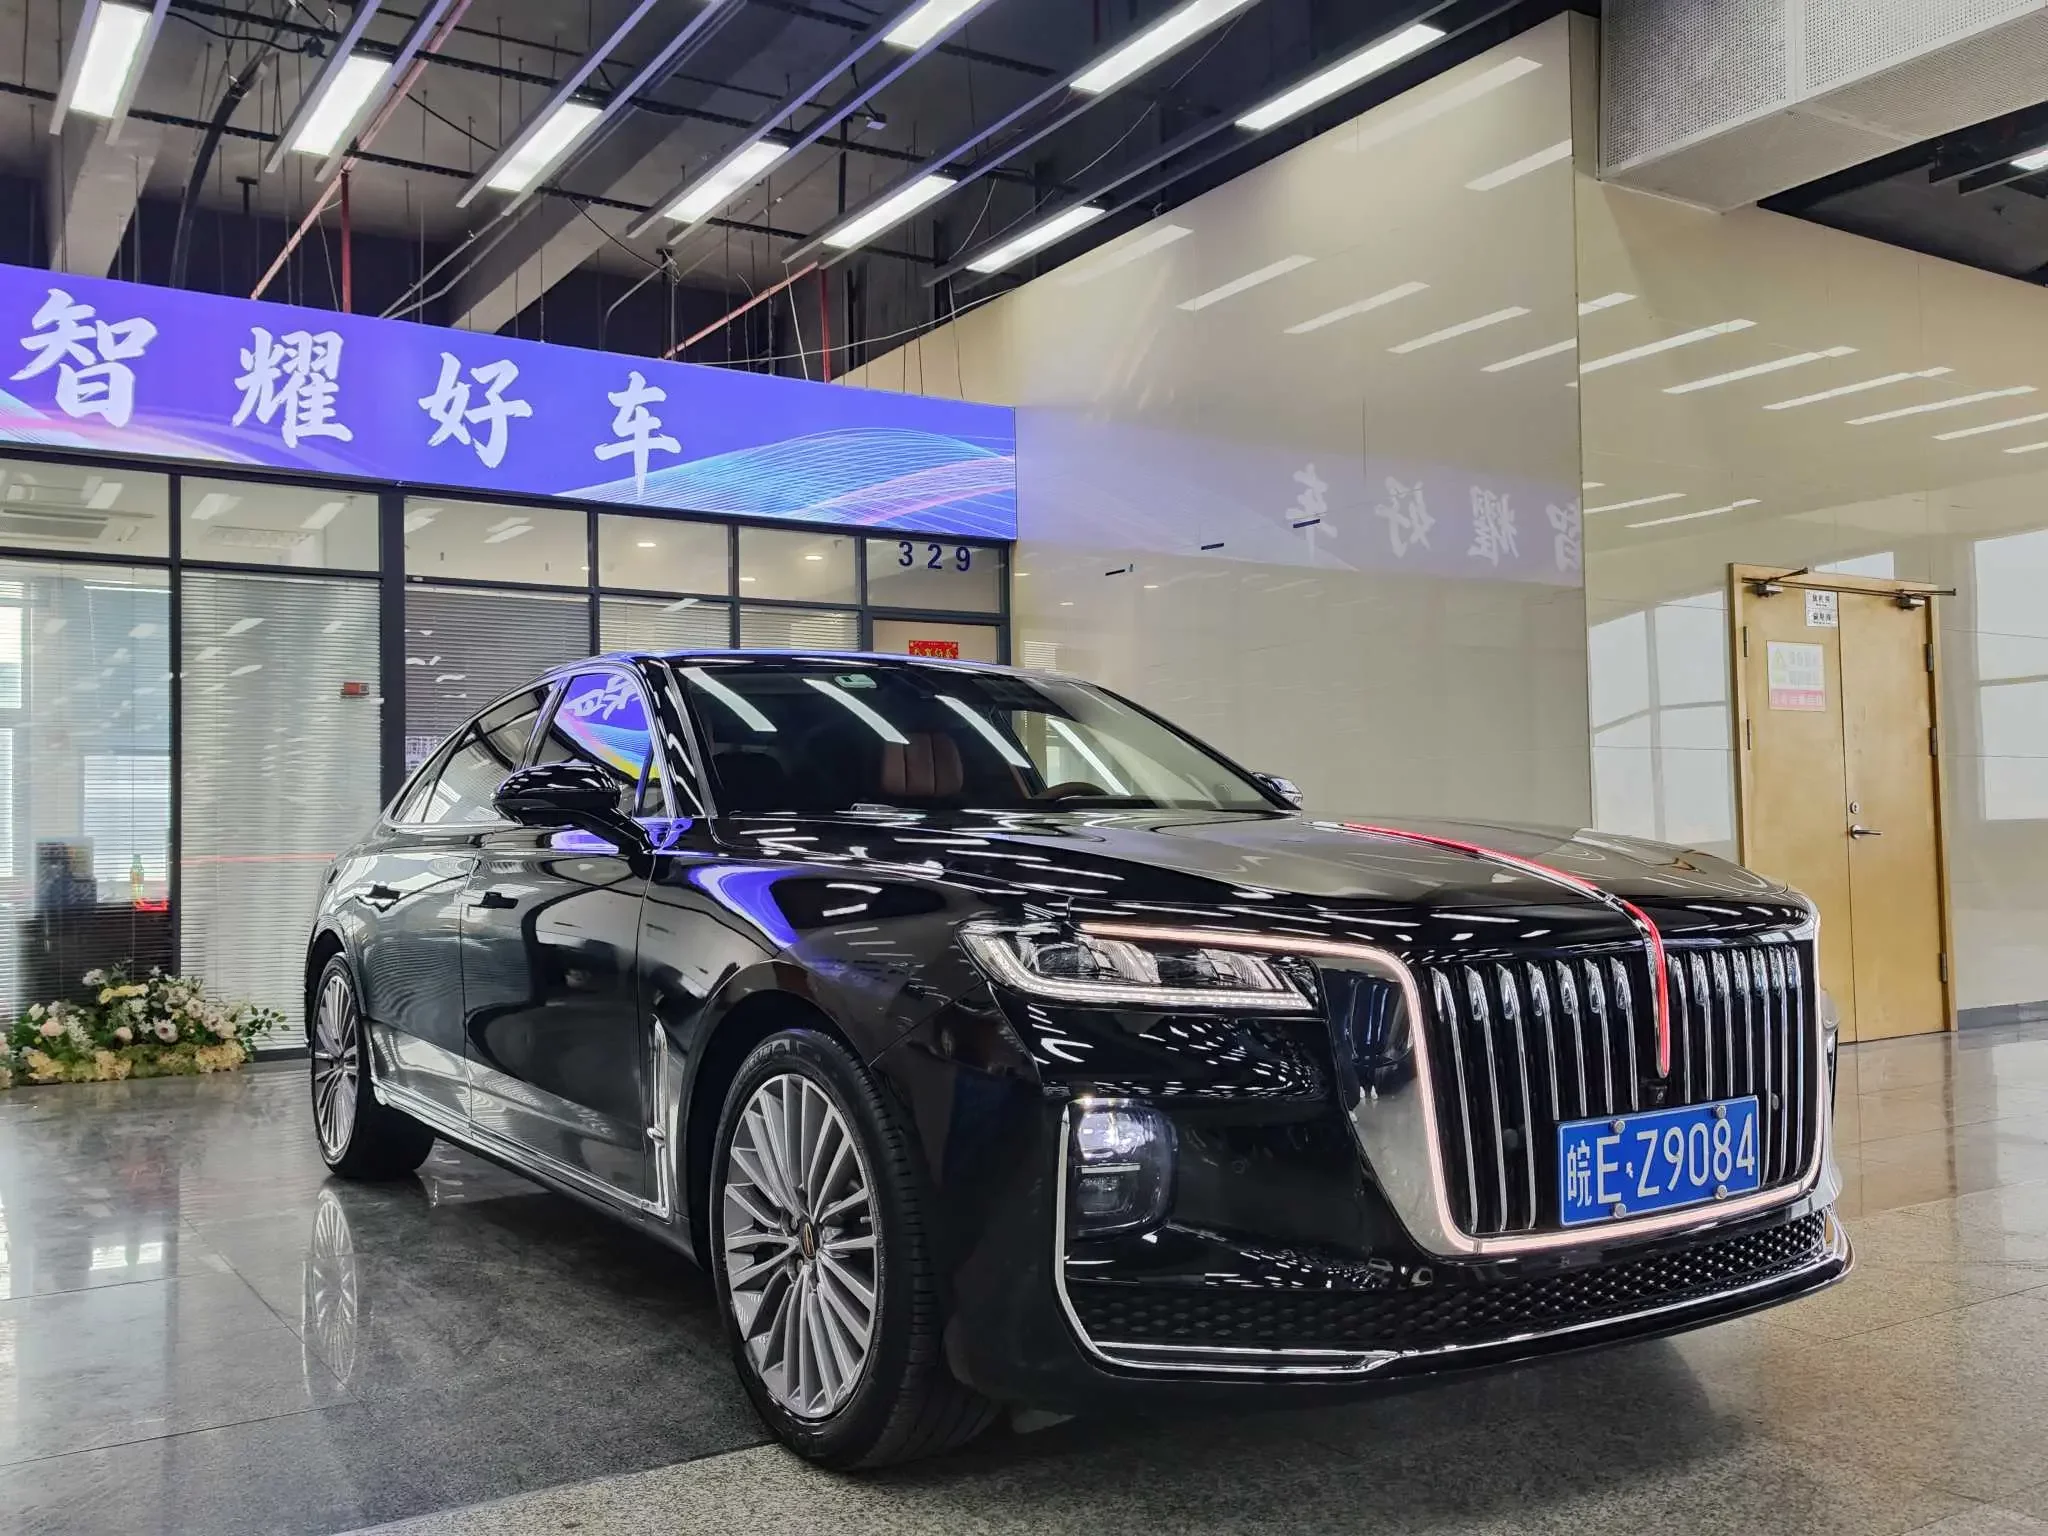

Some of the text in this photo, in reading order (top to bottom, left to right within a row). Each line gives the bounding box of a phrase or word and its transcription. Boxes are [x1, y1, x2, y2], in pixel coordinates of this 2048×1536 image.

[10, 288, 683, 498] 智耀好车
[898, 541, 971, 571] 329
